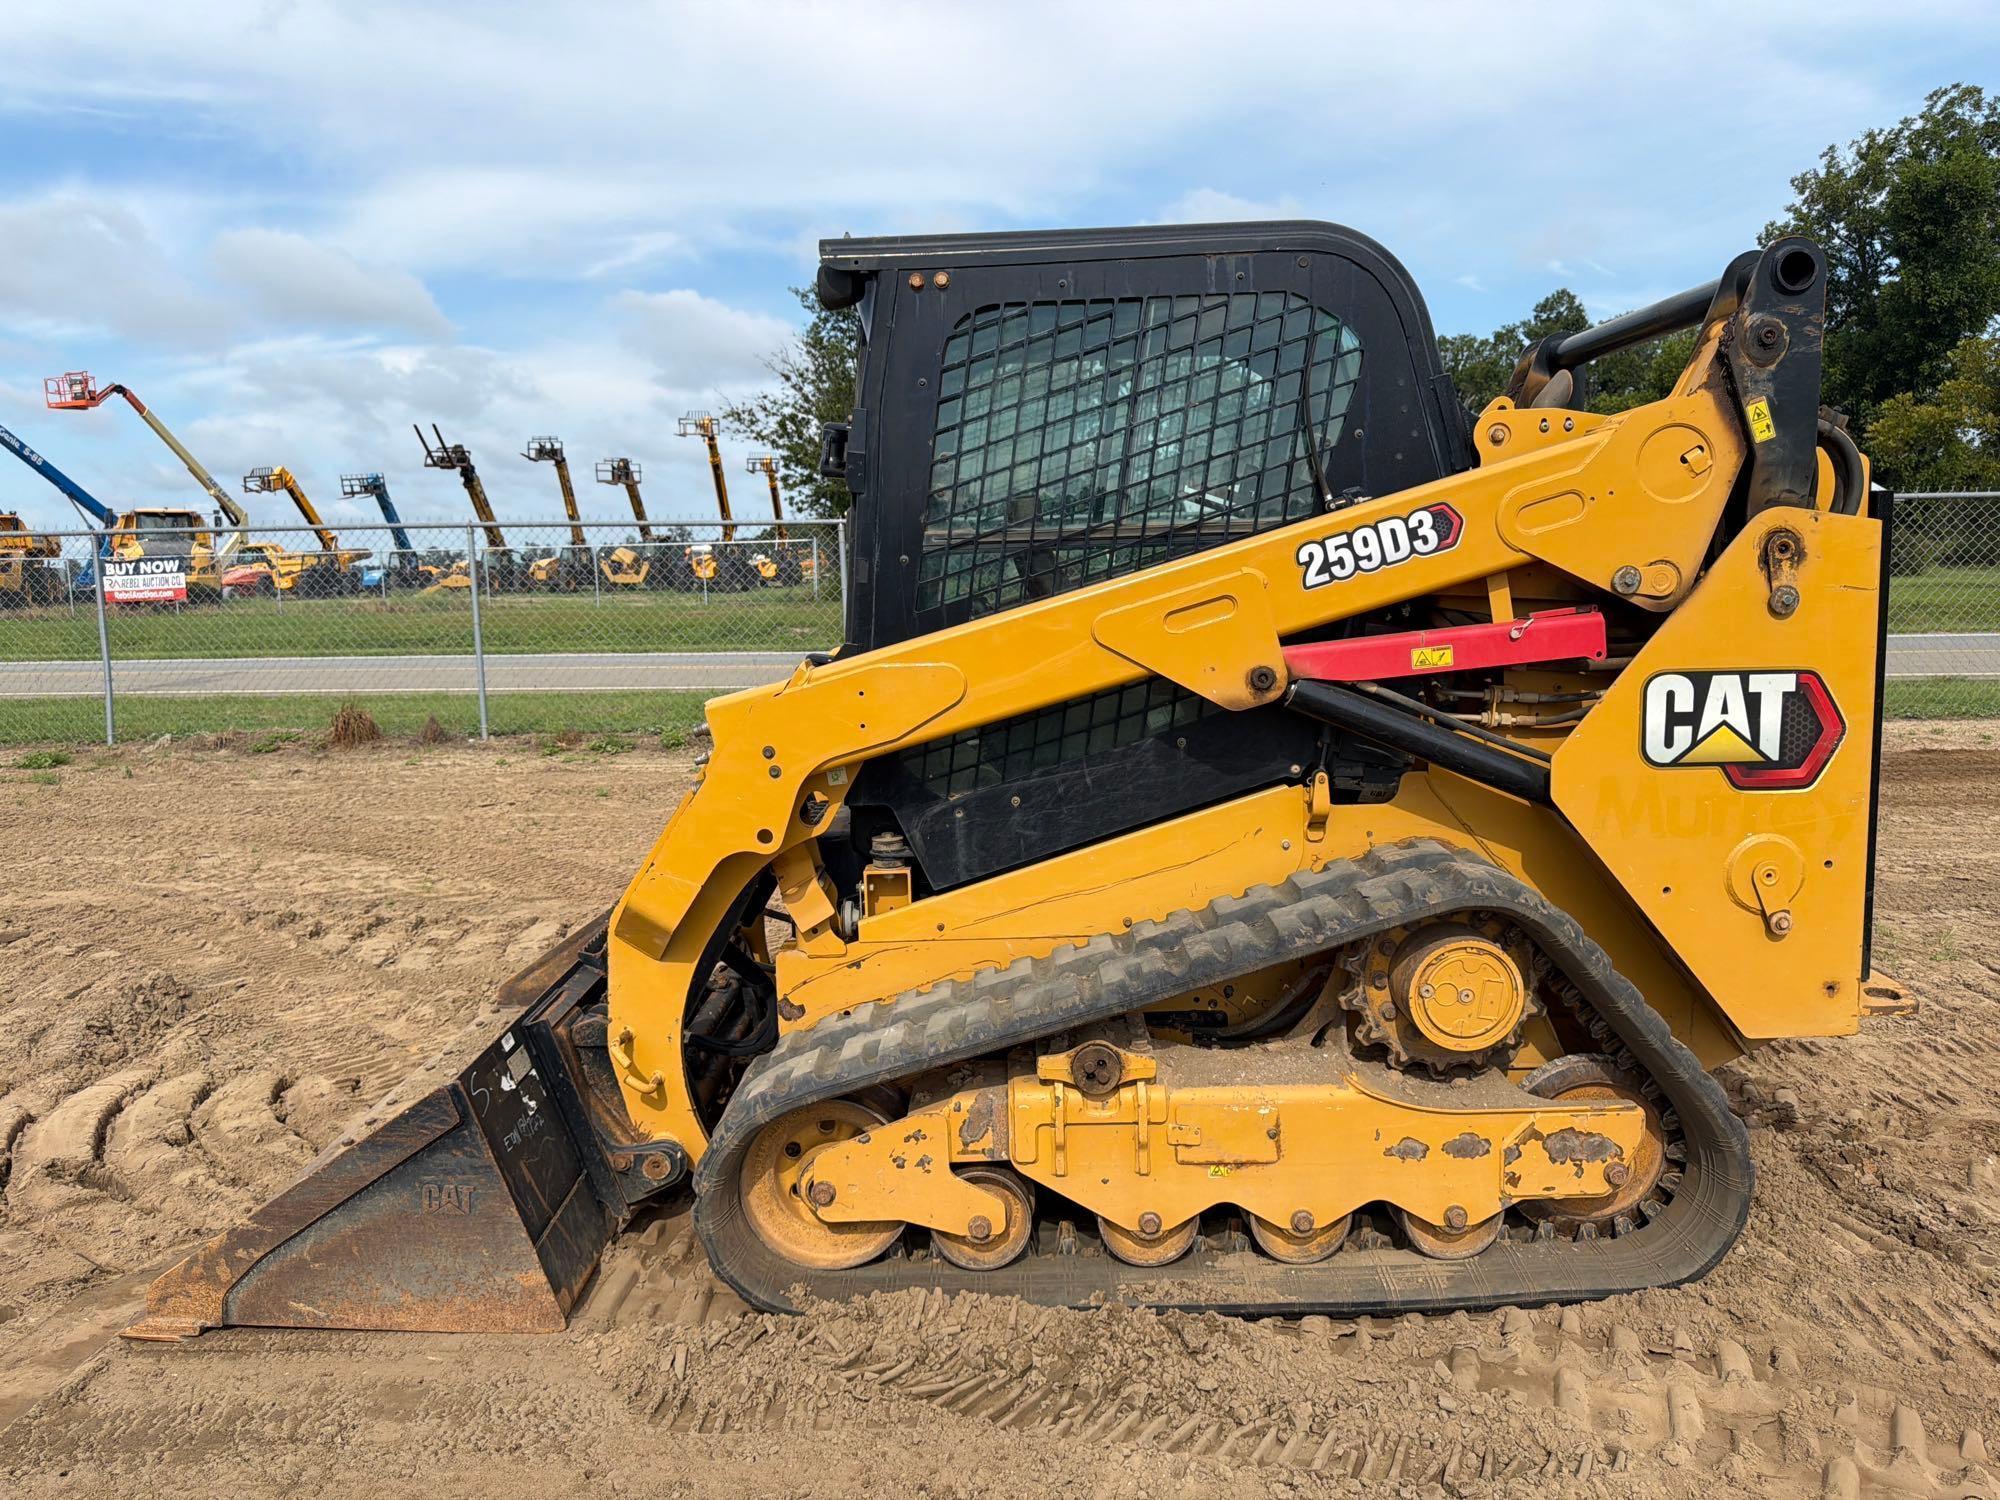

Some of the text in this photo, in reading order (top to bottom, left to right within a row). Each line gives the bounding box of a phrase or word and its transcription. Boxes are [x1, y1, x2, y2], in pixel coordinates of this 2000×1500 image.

[1298, 509, 1439, 588] 259D3
[105, 559, 180, 576] BUY NOW
[121, 578, 141, 589] REBEL
[143, 576, 170, 588] AUCTION
[1645, 673, 1797, 764] CAT
[421, 1183, 476, 1217] CAT
